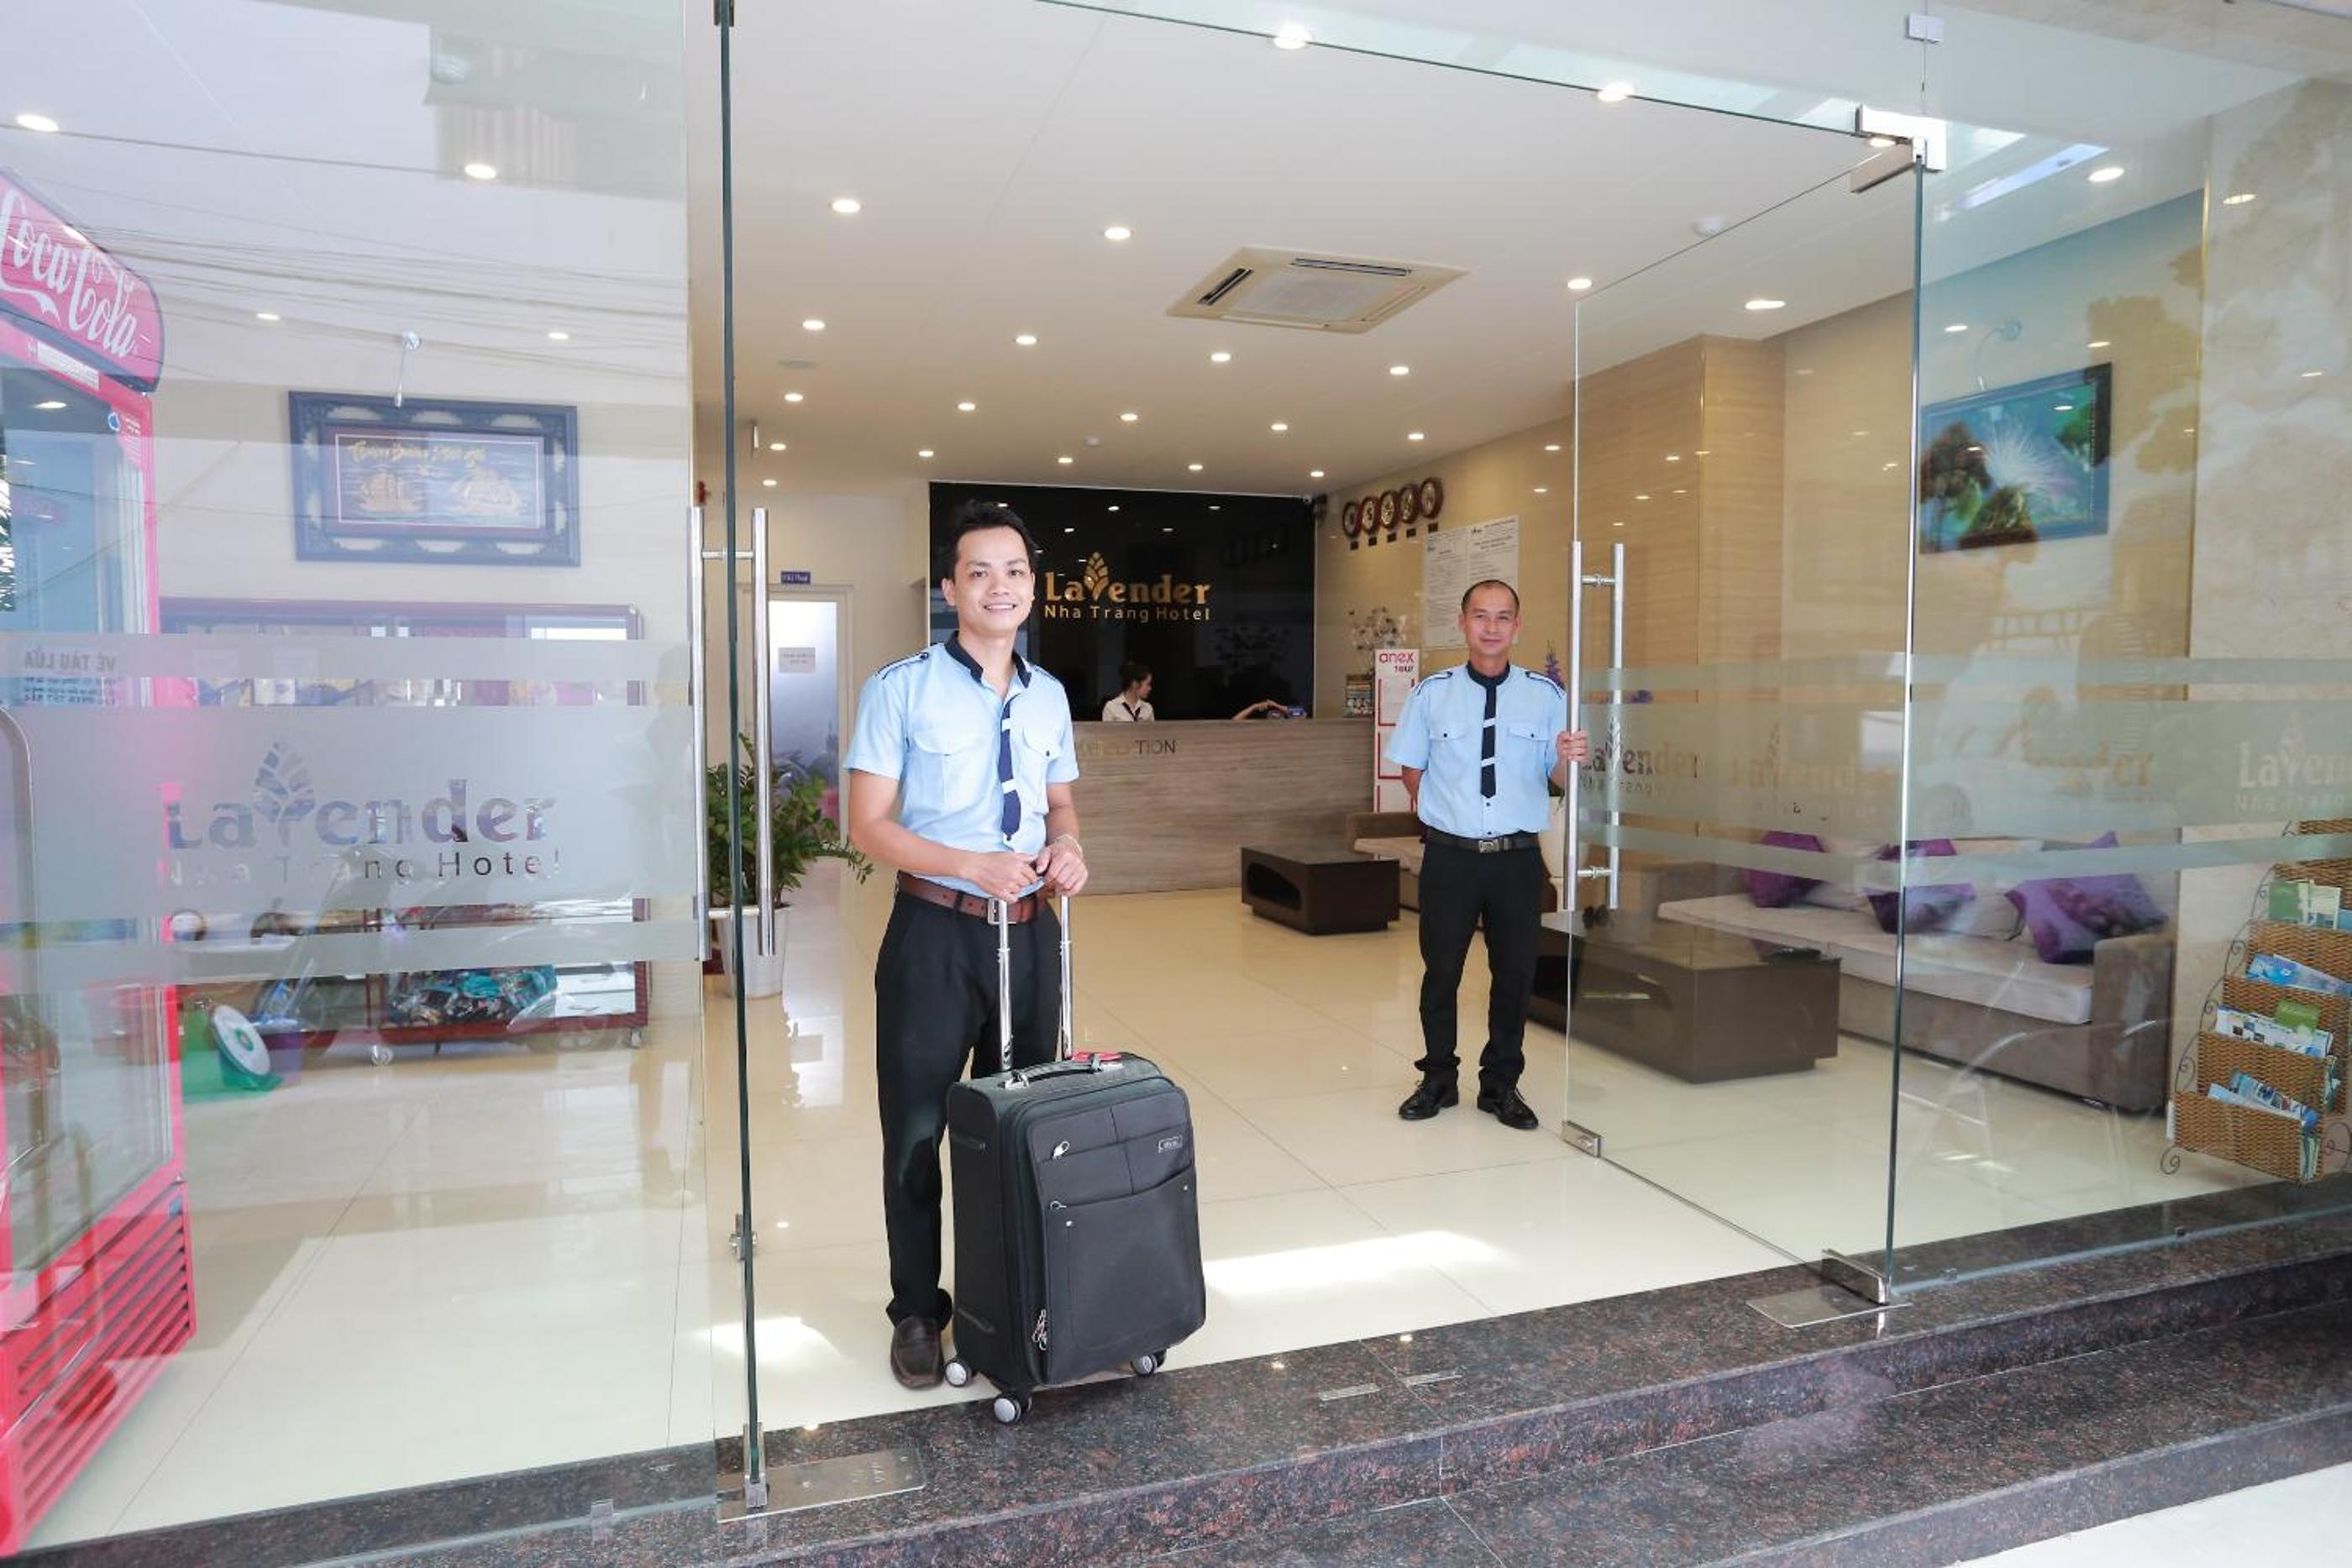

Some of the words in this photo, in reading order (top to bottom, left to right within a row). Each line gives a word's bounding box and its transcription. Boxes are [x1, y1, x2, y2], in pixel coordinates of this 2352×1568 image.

[1044, 605, 1082, 619] Nha
[1090, 605, 1149, 623] Trang
[1156, 606, 1210, 621] Hotel
[1378, 651, 1415, 663] anex
